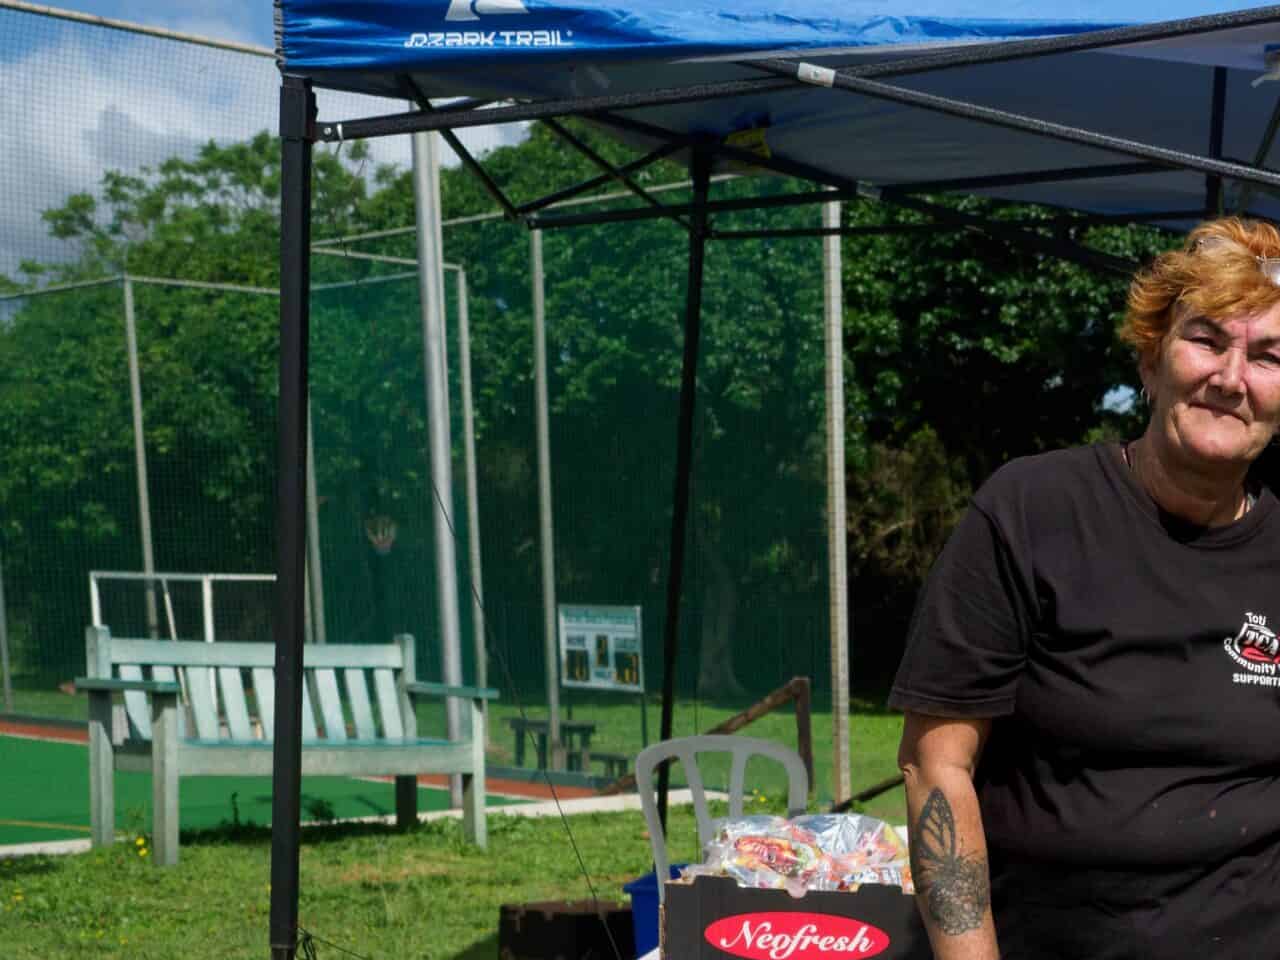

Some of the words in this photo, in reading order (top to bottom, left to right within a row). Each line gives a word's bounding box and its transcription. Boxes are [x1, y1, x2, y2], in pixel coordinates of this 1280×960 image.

[404, 31, 495, 48] OZARK
[500, 30, 573, 47] TRAIL
[1244, 630, 1279, 656] TCA
[720, 920, 873, 960] Neofresh
